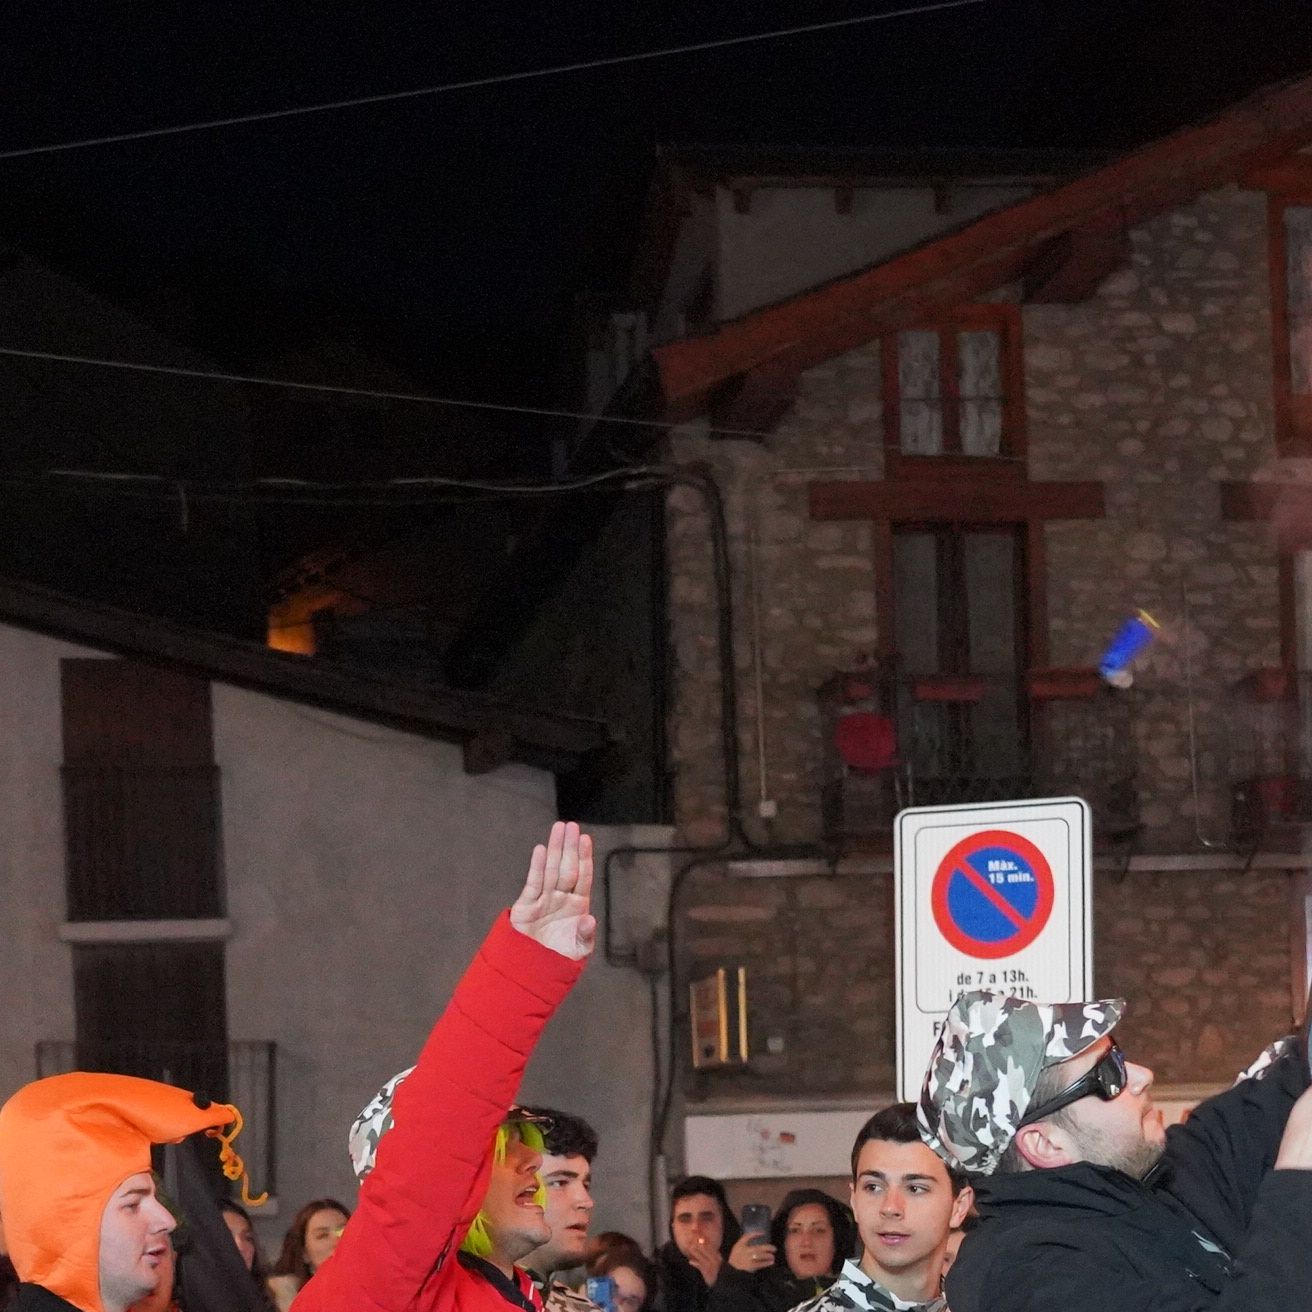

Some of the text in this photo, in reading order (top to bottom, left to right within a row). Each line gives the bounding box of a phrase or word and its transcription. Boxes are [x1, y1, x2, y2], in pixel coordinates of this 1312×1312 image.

[989, 871, 1035, 884] 15 min.
[957, 970, 1030, 985] de 7 a 13h.
